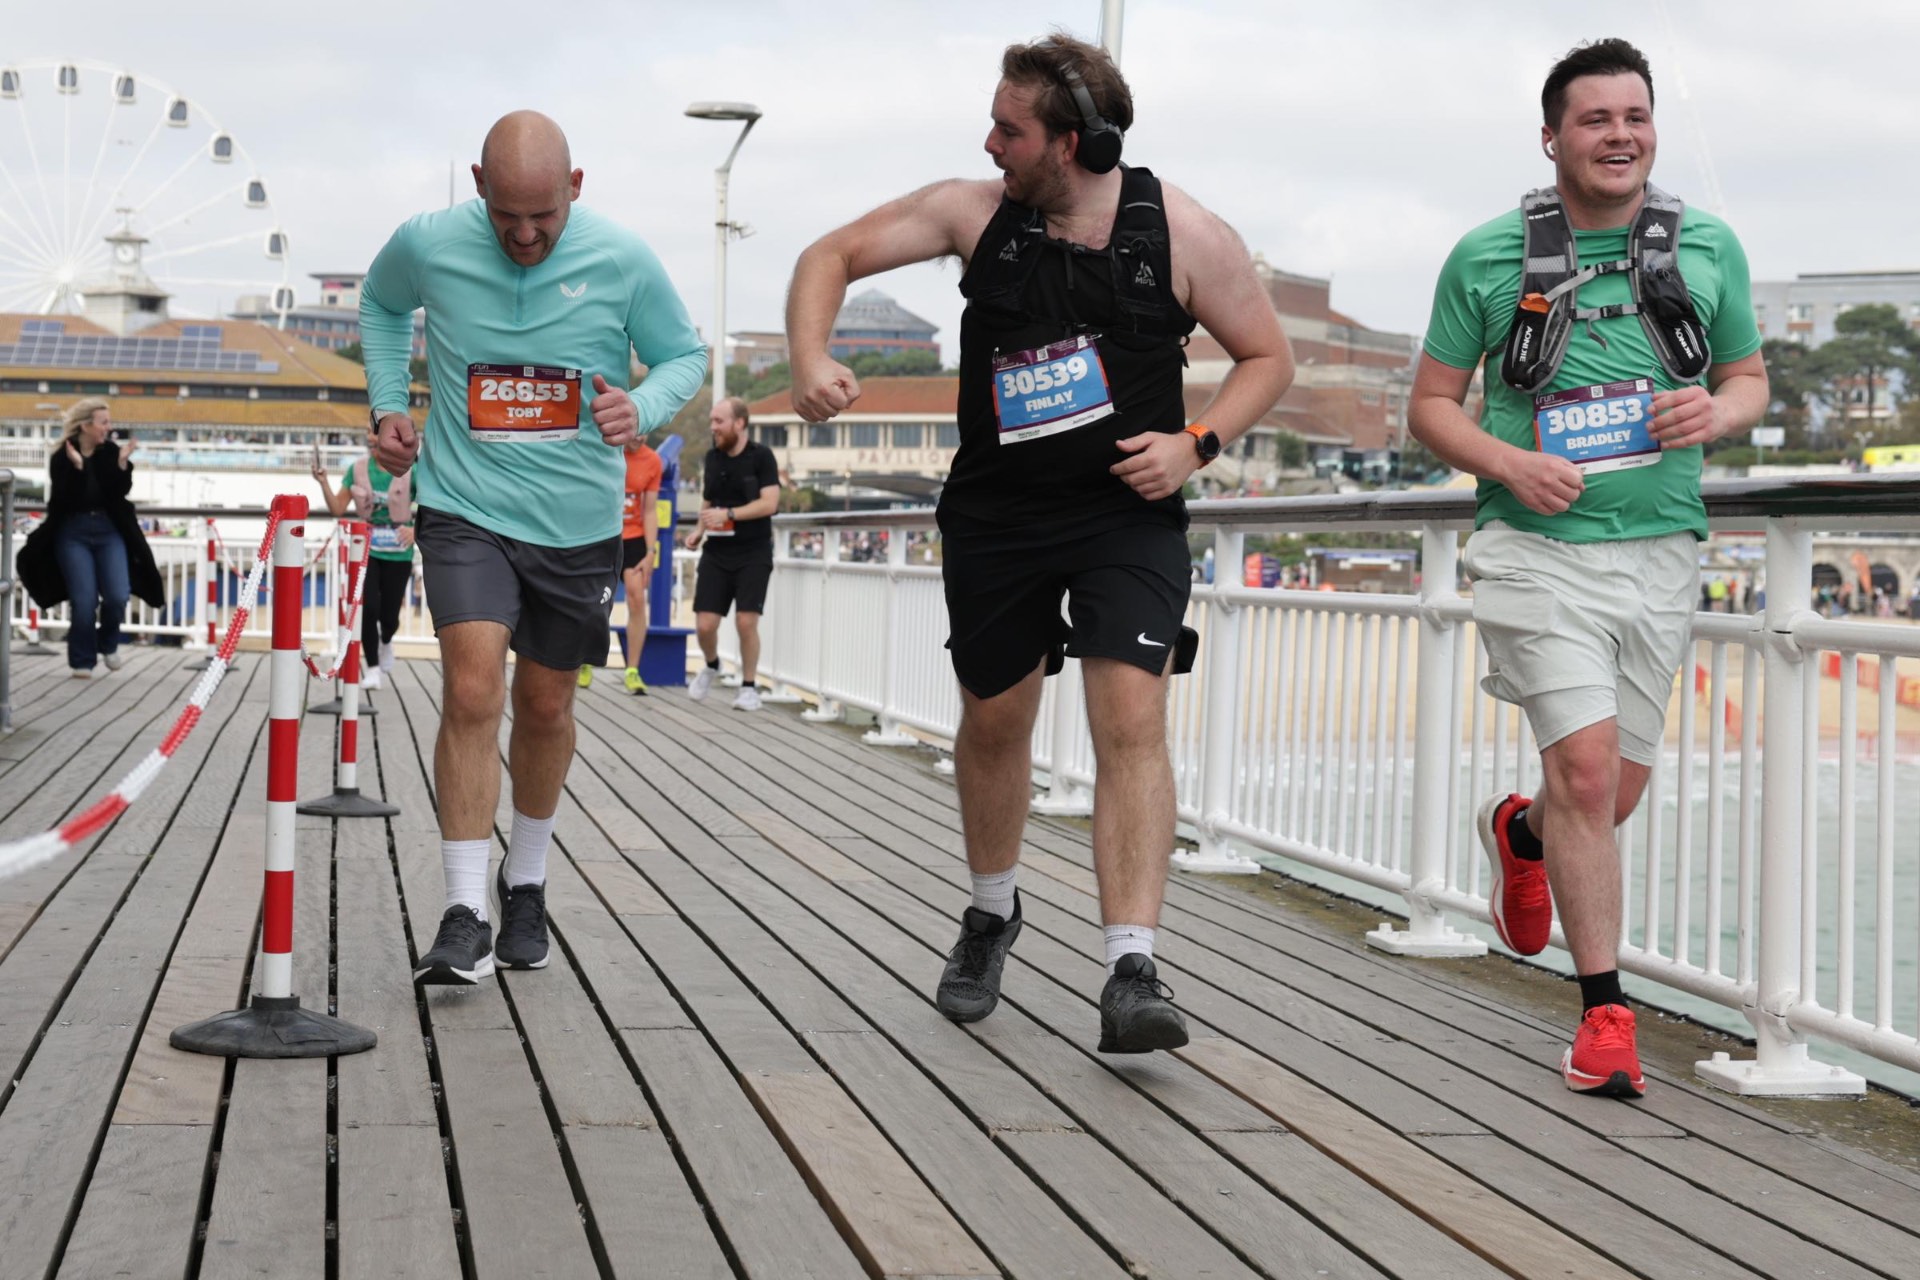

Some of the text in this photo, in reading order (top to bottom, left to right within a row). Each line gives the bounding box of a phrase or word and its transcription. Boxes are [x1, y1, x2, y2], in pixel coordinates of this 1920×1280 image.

[1519, 325, 1533, 362] AONIJIE
[1673, 327, 1695, 360] AONIJIE
[480, 378, 568, 402] 26853
[1002, 356, 1089, 398] 30539
[506, 406, 543, 418] TOBY
[1025, 390, 1074, 412] FINLAY
[1546, 398, 1644, 434] 30853
[1566, 429, 1632, 450] BRADLEY
